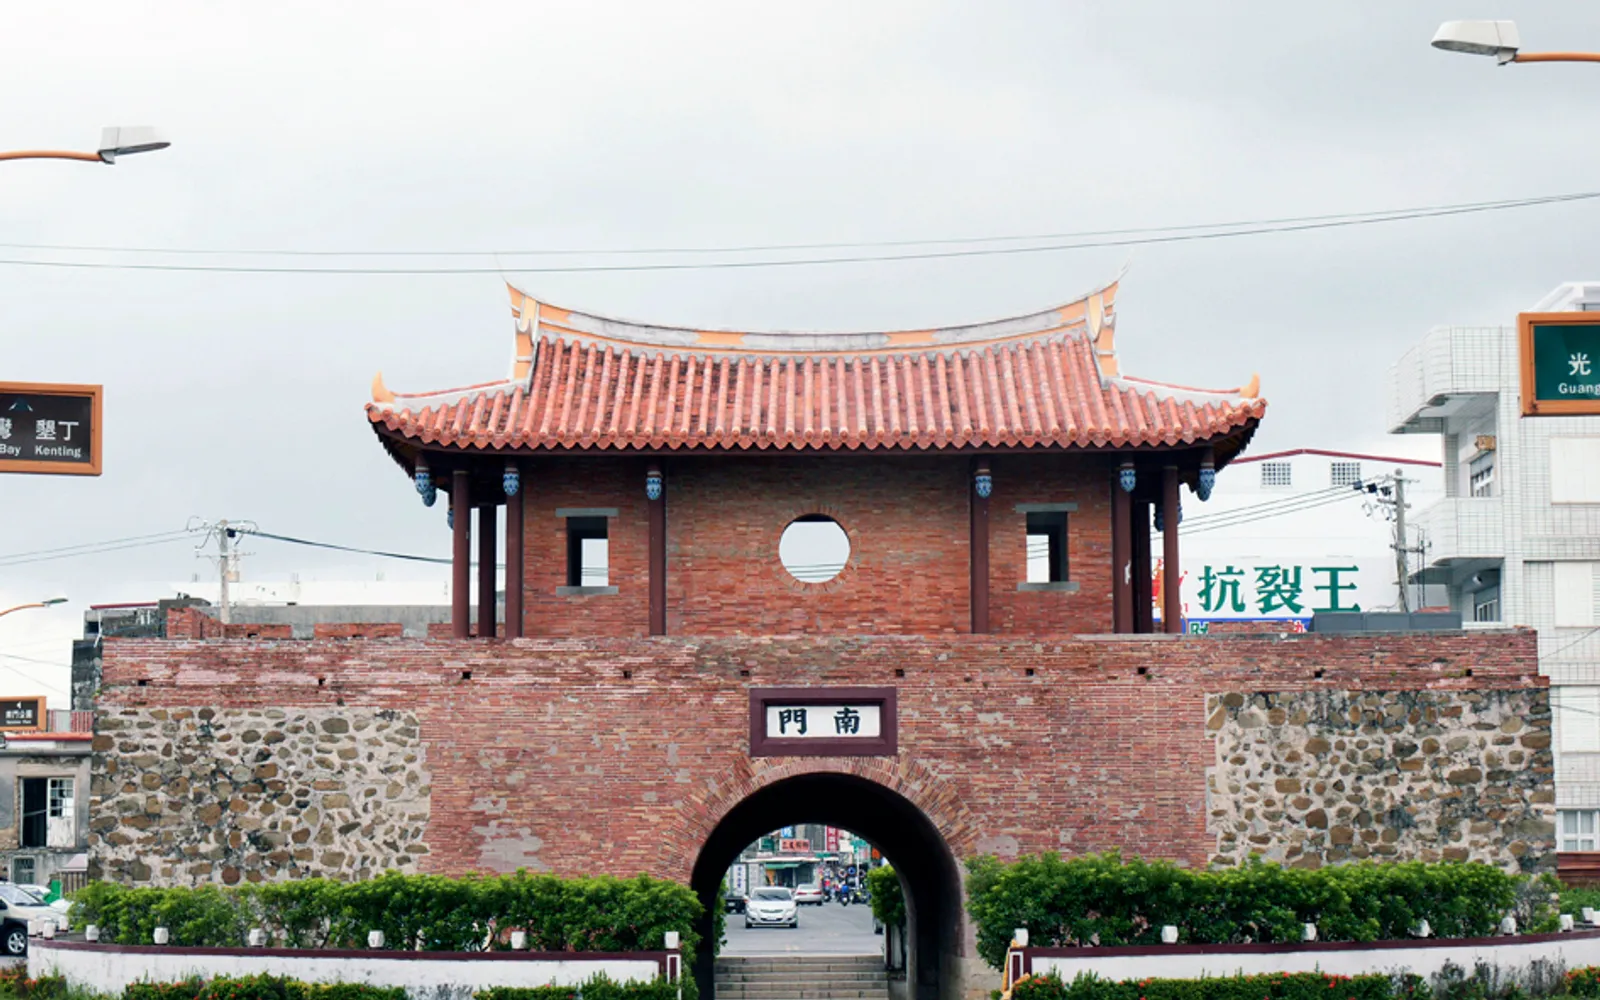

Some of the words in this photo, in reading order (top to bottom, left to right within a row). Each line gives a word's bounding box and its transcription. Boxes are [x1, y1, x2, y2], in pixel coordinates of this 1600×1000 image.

[1568, 352, 1592, 376] 光
[35, 419, 79, 441] 墾丁
[0, 444, 21, 457] Bay
[34, 445, 82, 459] Kenting
[1197, 565, 1361, 614] 抗裂王
